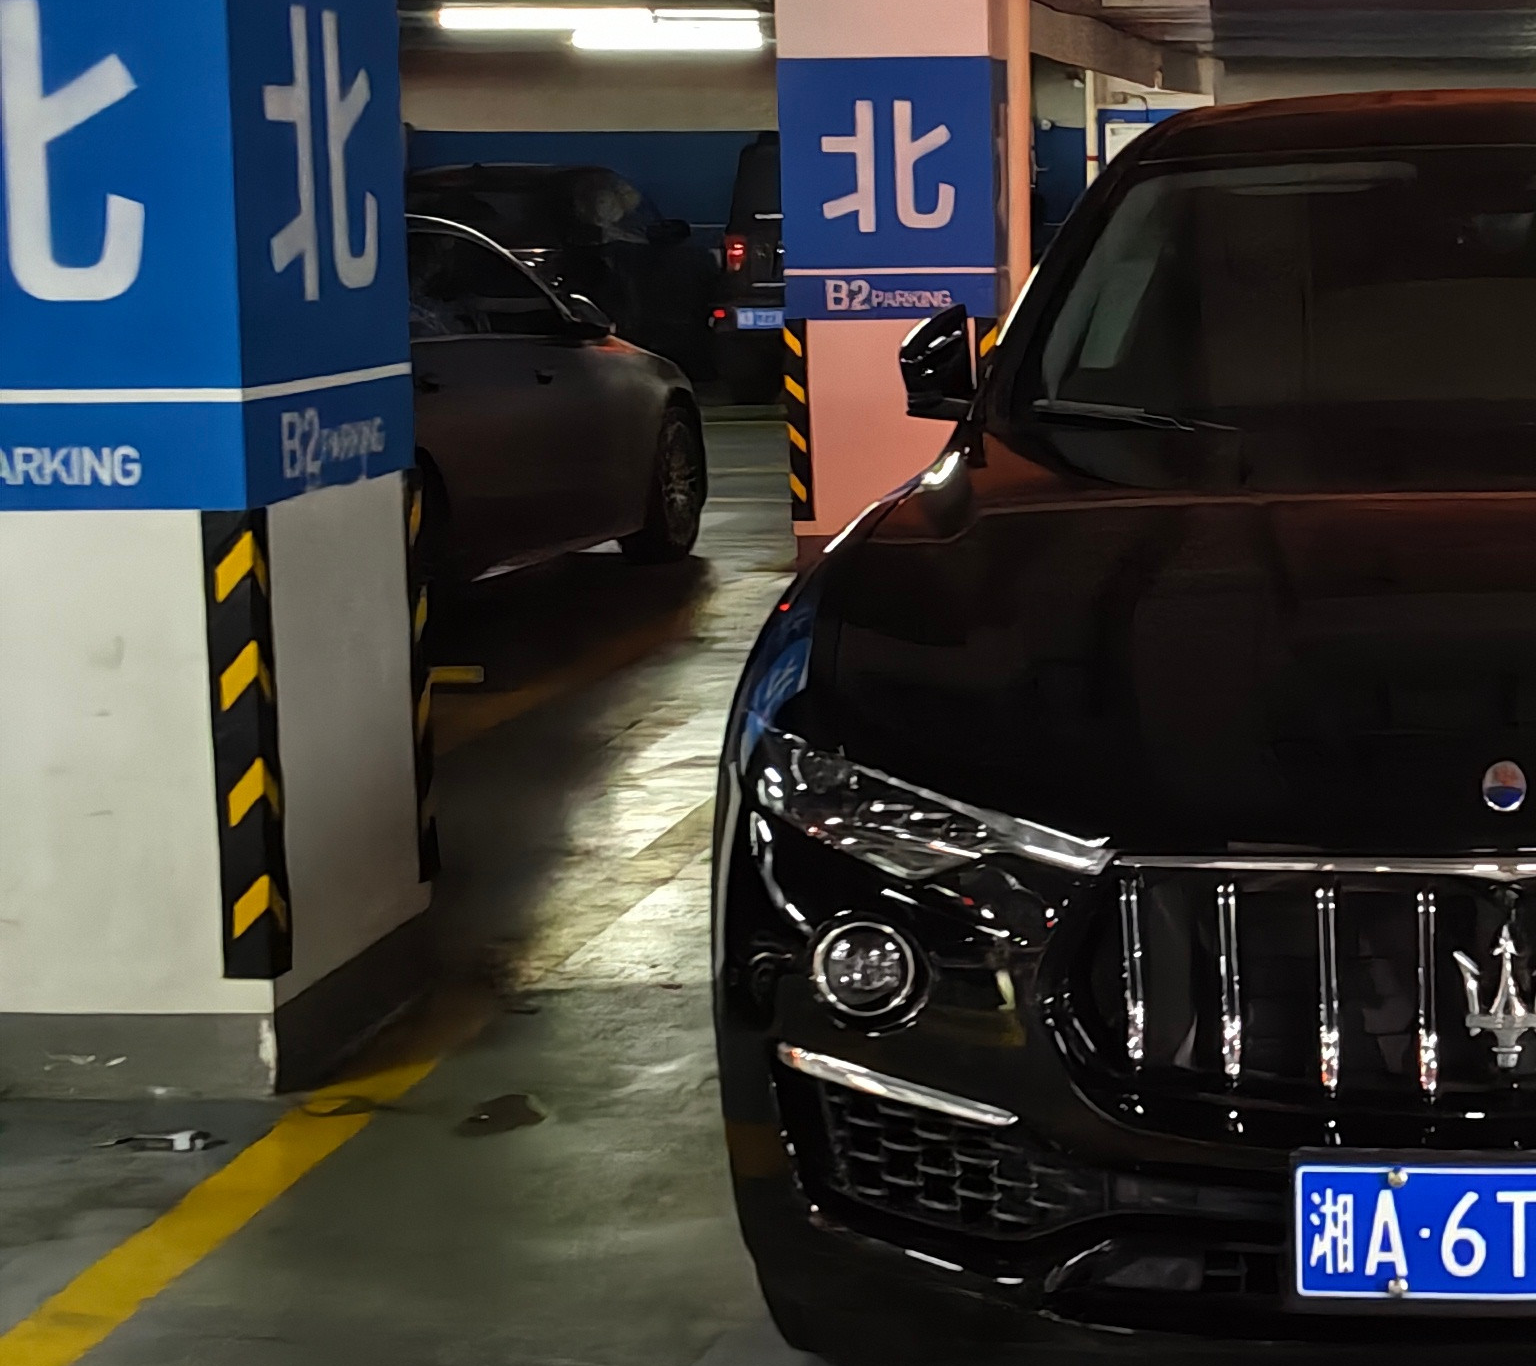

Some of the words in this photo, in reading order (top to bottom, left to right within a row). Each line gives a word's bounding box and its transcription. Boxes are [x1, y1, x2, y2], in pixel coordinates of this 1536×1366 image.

[263, 4, 379, 302] 北
[820, 99, 956, 234] 北
[825, 279, 871, 311] B2
